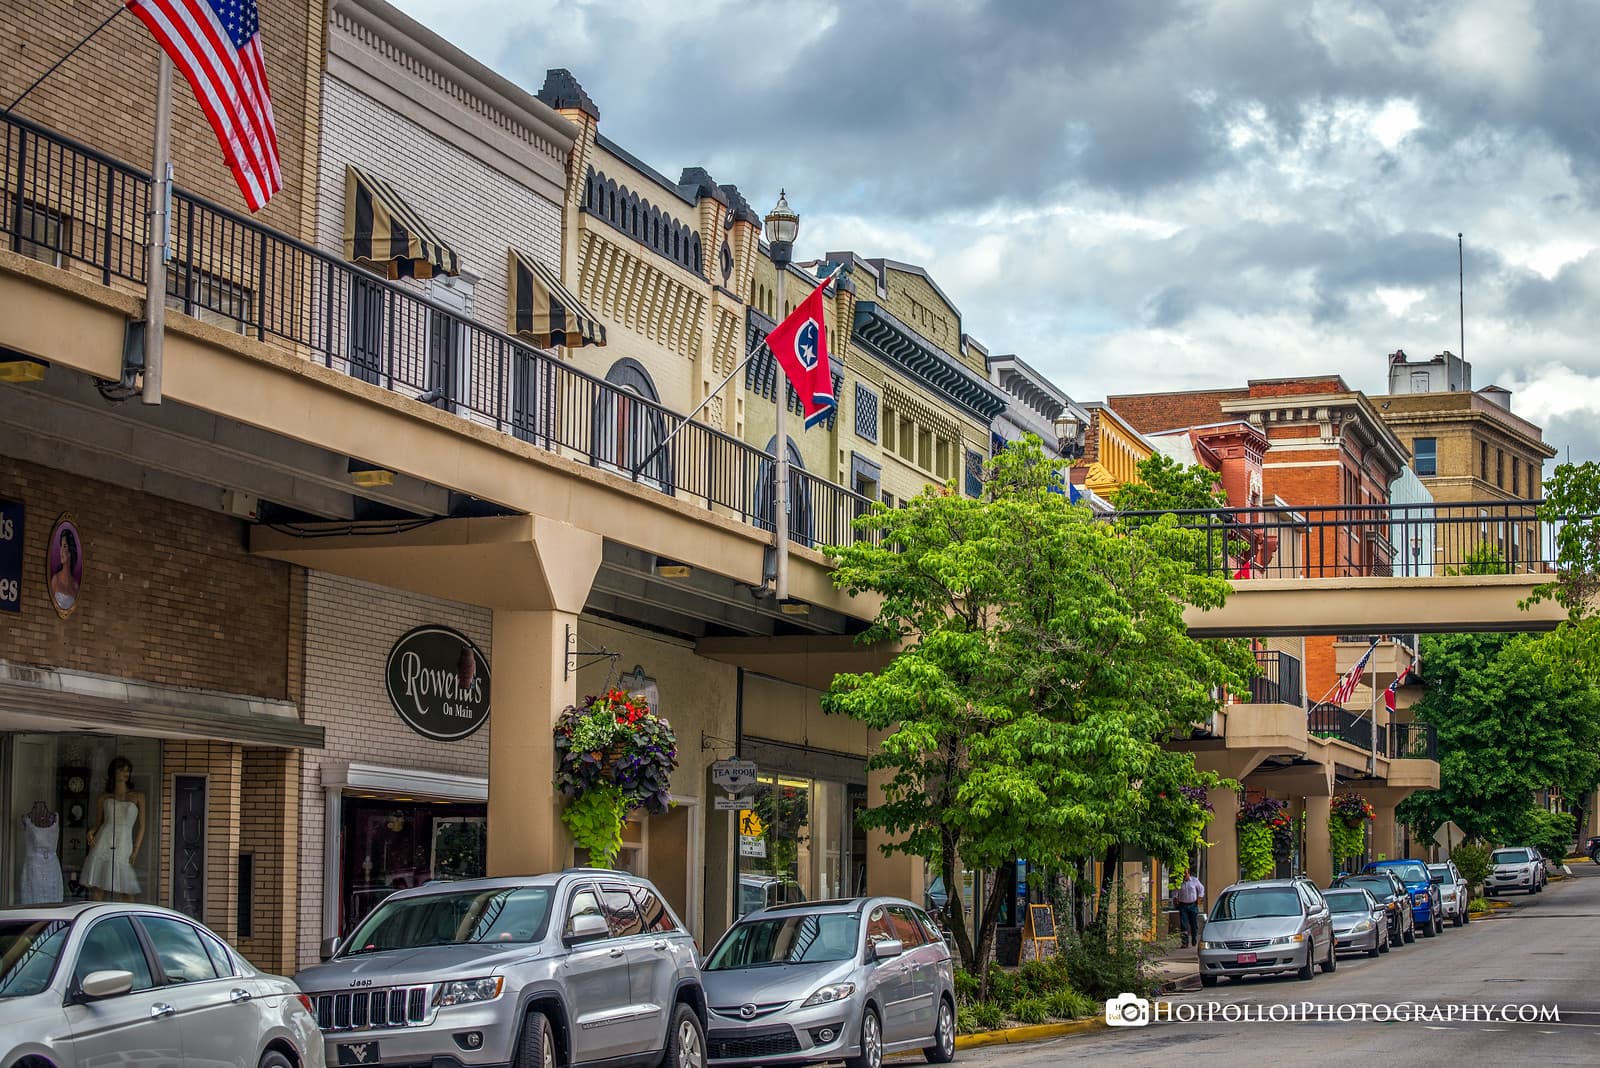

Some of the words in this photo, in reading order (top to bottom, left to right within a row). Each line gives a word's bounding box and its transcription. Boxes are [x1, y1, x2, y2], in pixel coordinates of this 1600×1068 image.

[443, 702, 453, 716] On
[455, 704, 473, 719] Main
[713, 768, 730, 779] TEA
[732, 768, 756, 779] ROOM
